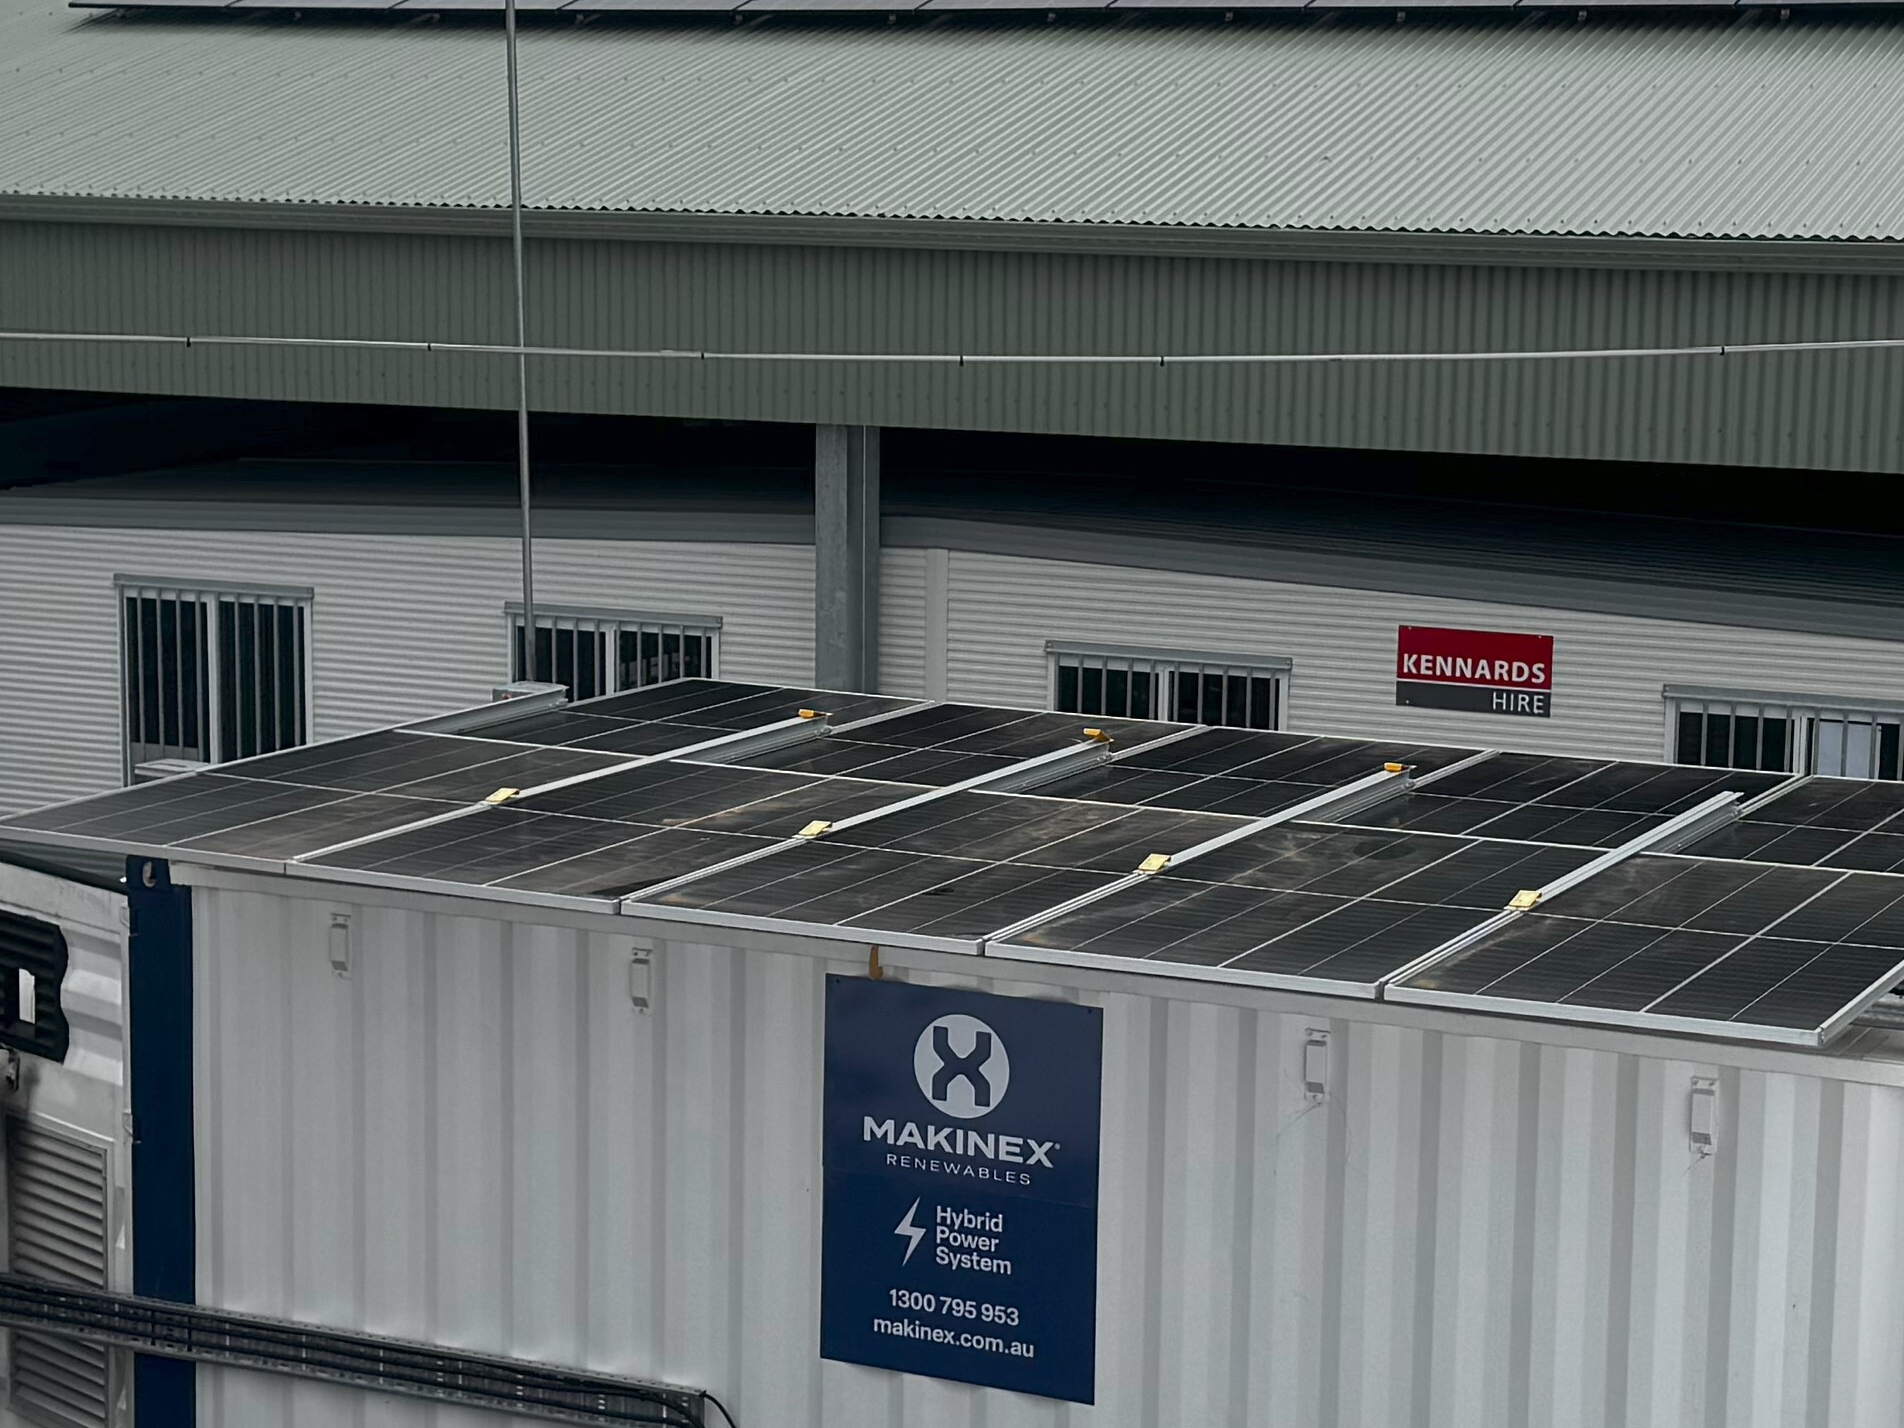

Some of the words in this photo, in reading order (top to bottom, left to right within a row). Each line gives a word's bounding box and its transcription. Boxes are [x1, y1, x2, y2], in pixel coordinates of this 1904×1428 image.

[1403, 653, 1546, 684] KENNARDS
[1492, 691, 1545, 714] HIRE
[863, 1116, 1054, 1168] MAKINEX
[886, 1153, 1031, 1186] RENEWABLES
[936, 1205, 1003, 1233] Hybrid
[936, 1226, 1000, 1252] Power
[935, 1246, 1012, 1275] System
[889, 1288, 936, 1313] 1300
[939, 1296, 977, 1319] 795
[981, 1303, 1020, 1326] 953
[873, 1318, 1035, 1358] makinex.com.au
